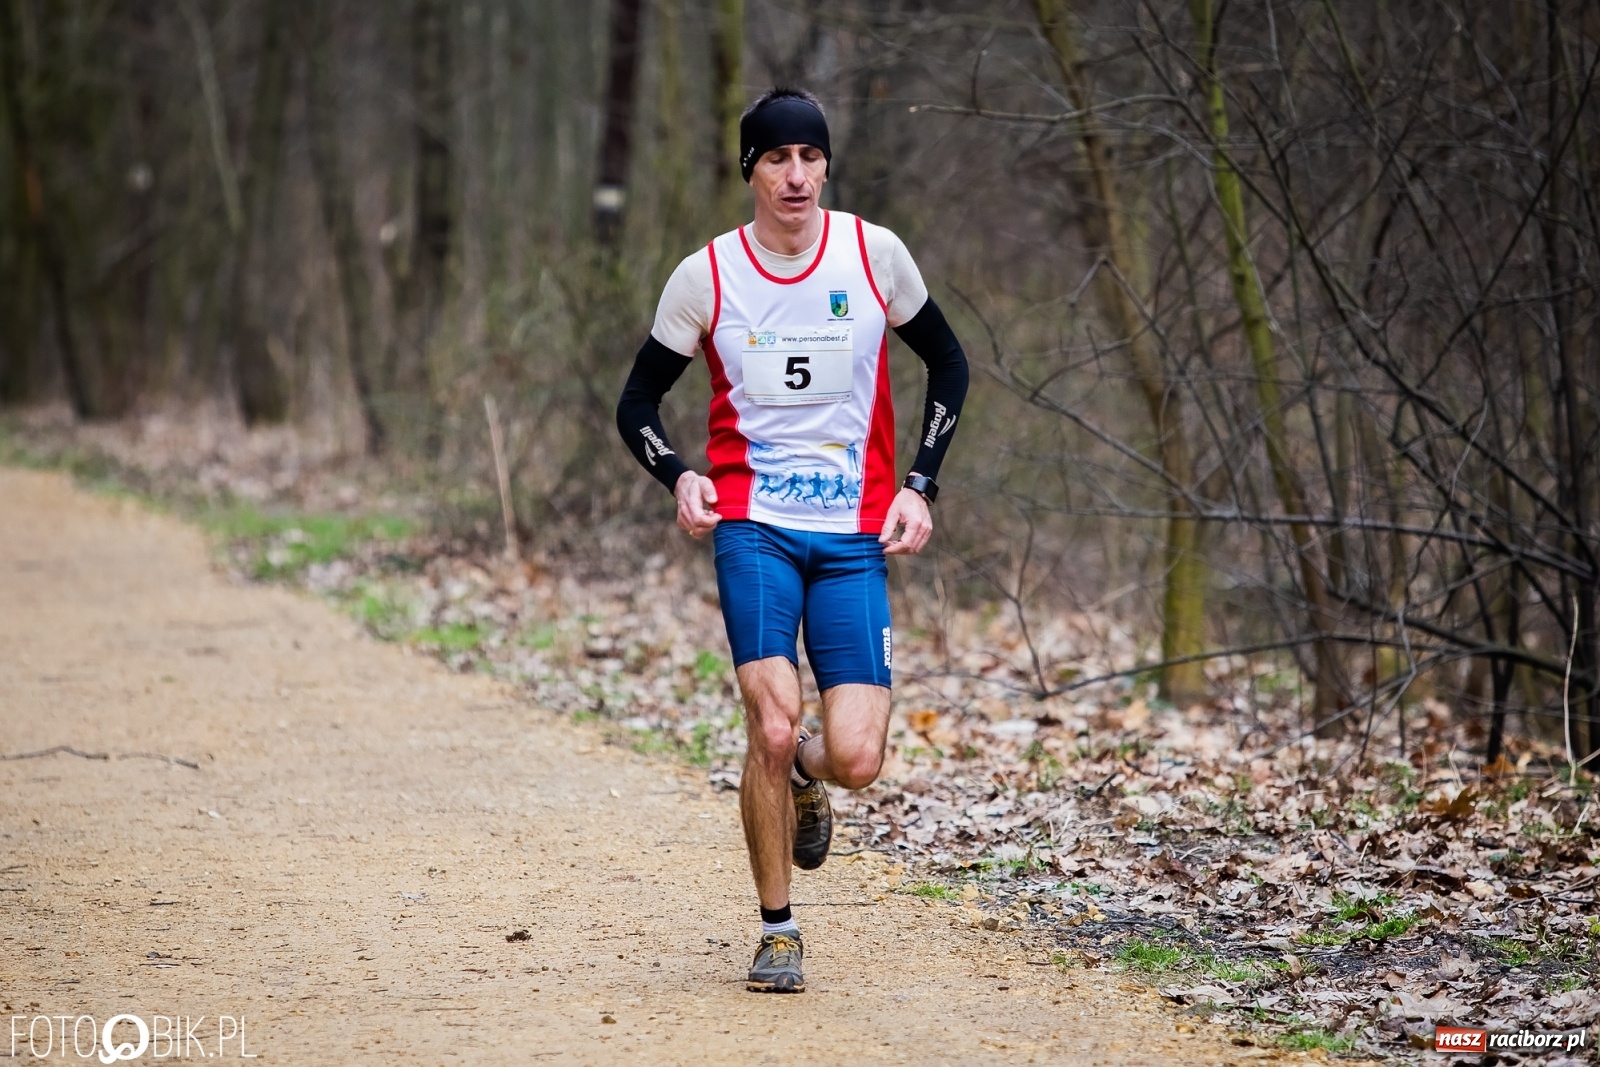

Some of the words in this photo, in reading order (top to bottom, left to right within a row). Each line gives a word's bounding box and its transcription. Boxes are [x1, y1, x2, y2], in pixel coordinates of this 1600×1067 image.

[784, 356, 812, 390] 5
[639, 425, 675, 457] Rogelli
[924, 401, 947, 449] Rogelli
